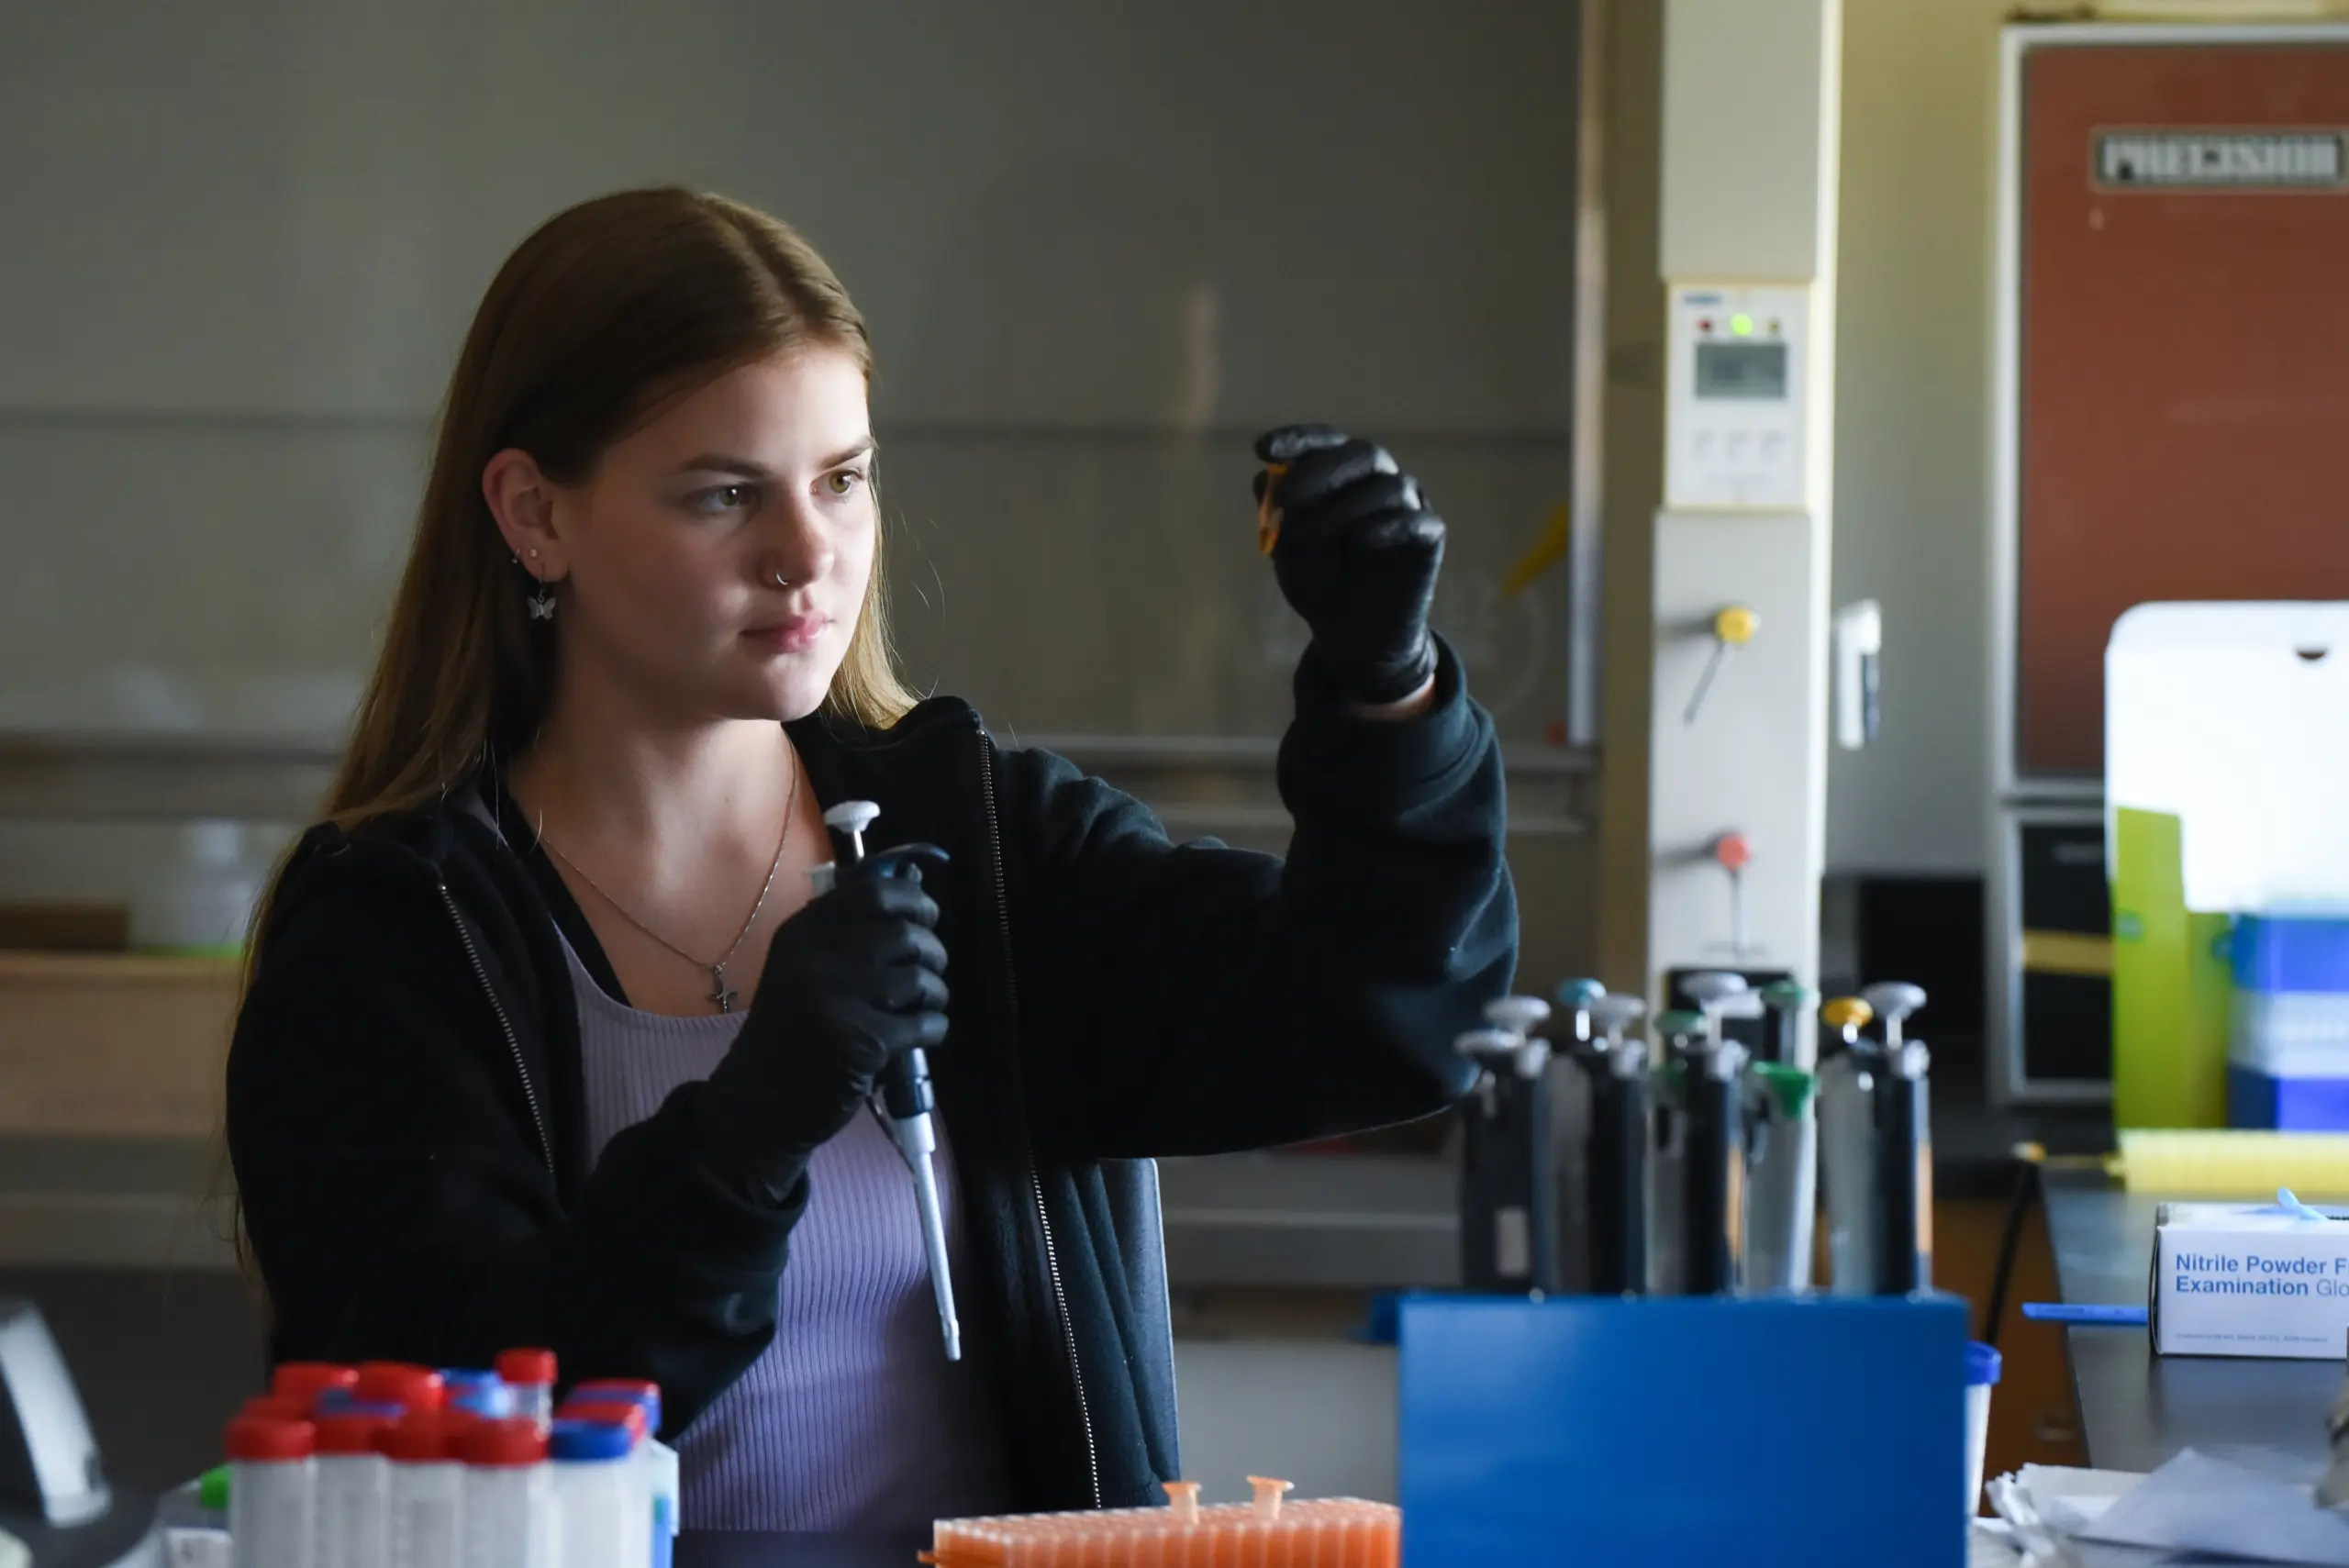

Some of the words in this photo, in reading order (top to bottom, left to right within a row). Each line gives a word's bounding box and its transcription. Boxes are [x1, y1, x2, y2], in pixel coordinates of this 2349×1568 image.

[2176, 1253, 2239, 1272] Nitrile
[2246, 1255, 2328, 1275] Powder
[2334, 1258, 2349, 1275] F
[2176, 1275, 2310, 1296] Examination
[2316, 1278, 2349, 1297] Glo
